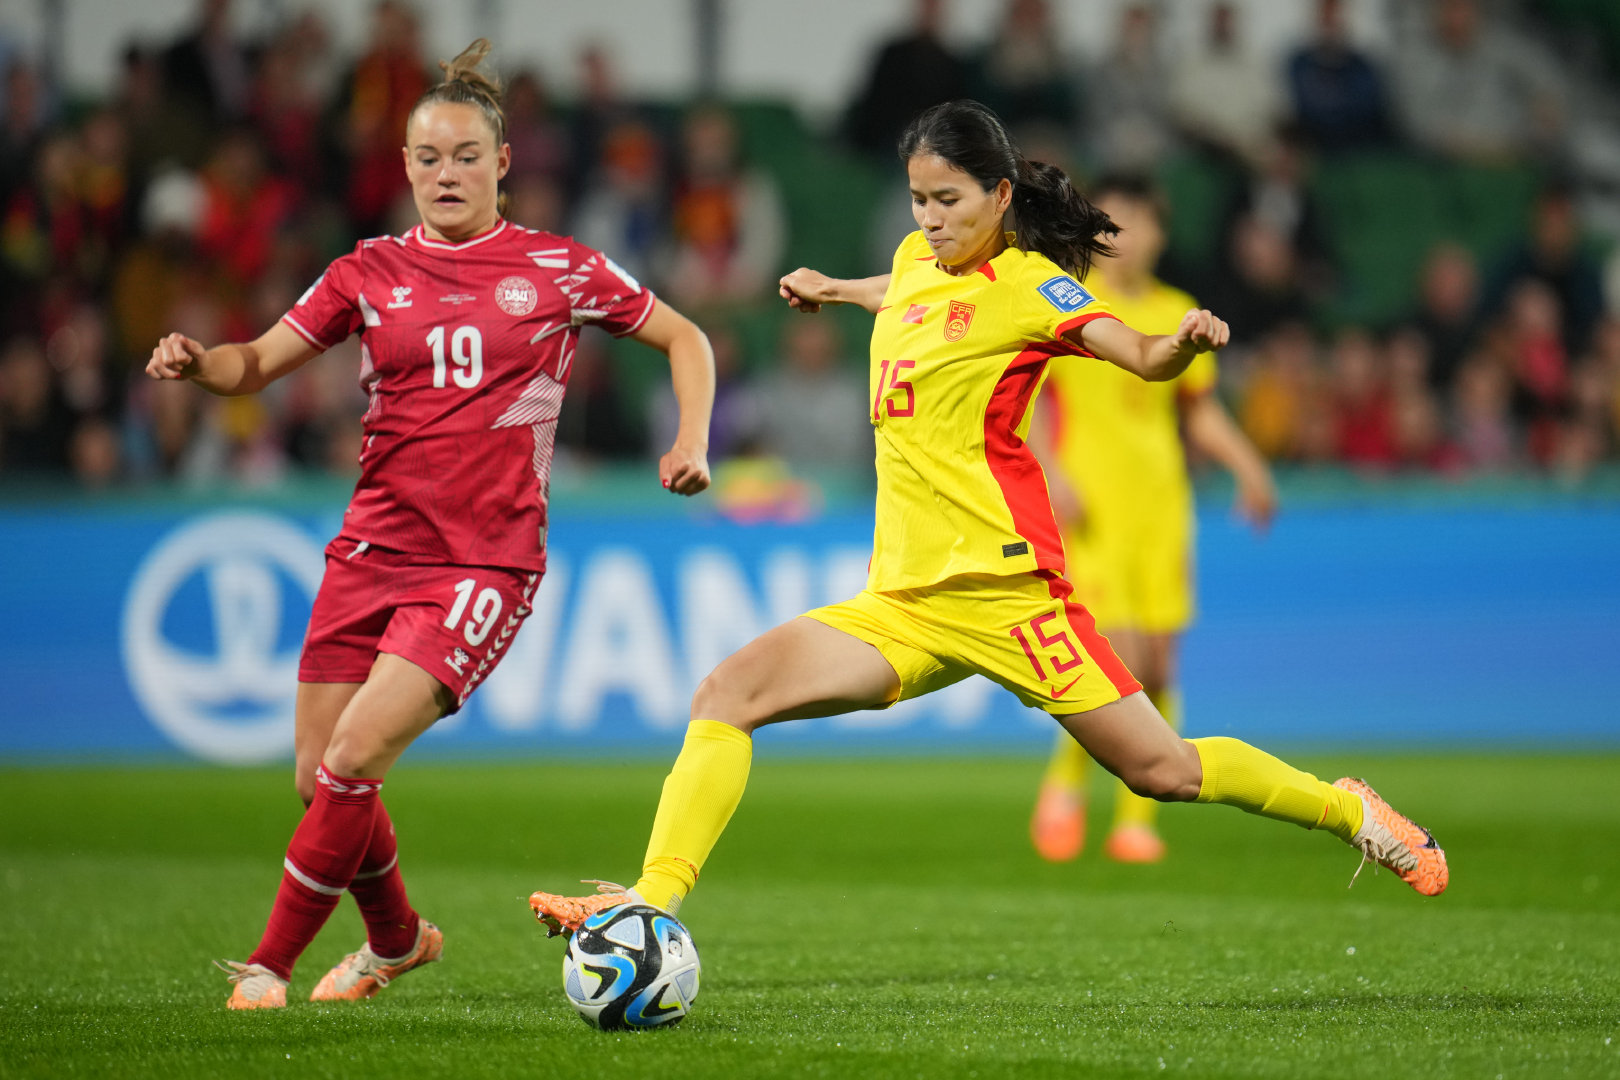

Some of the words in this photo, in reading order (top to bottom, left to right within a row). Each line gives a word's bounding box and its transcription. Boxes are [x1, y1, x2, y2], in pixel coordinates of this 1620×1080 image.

[504, 289, 528, 302] DBU
[952, 304, 971, 316] CFA
[426, 325, 483, 389] 19
[874, 360, 916, 420] 15
[443, 578, 502, 647] 19
[1009, 611, 1083, 682] 15
